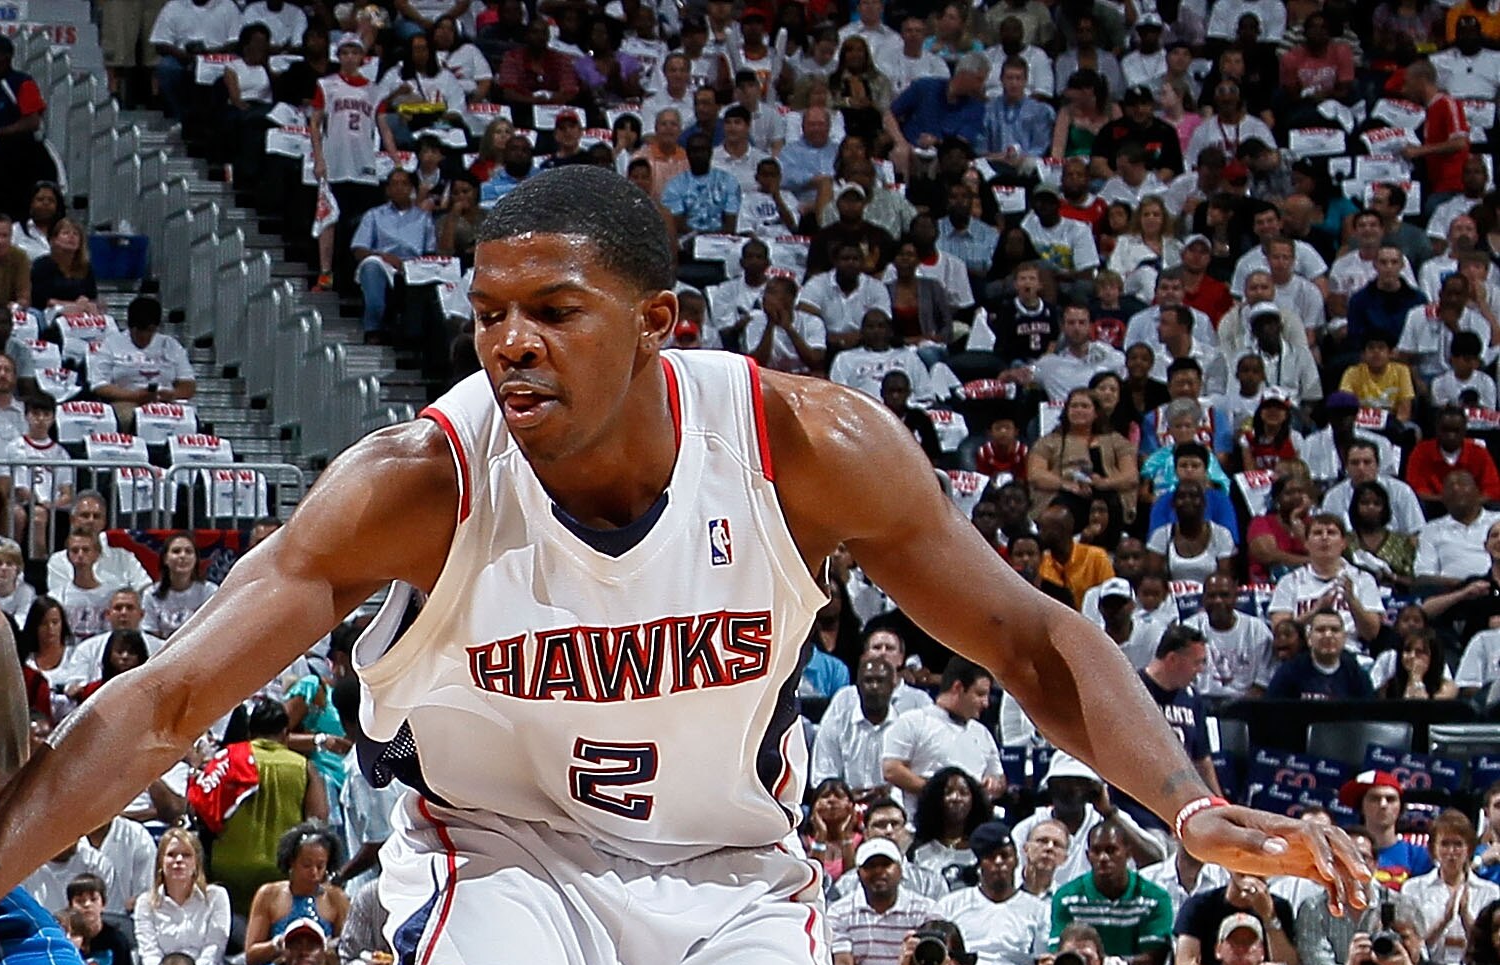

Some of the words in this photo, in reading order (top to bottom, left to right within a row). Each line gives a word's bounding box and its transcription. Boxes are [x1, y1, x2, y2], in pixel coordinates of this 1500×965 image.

[61, 402, 104, 414] KNOW
[141, 404, 185, 417] KNOW
[90, 431, 133, 444] KNOW
[177, 434, 220, 448] KNOW
[466, 610, 773, 703] HAWKS
[569, 737, 659, 821] 2
